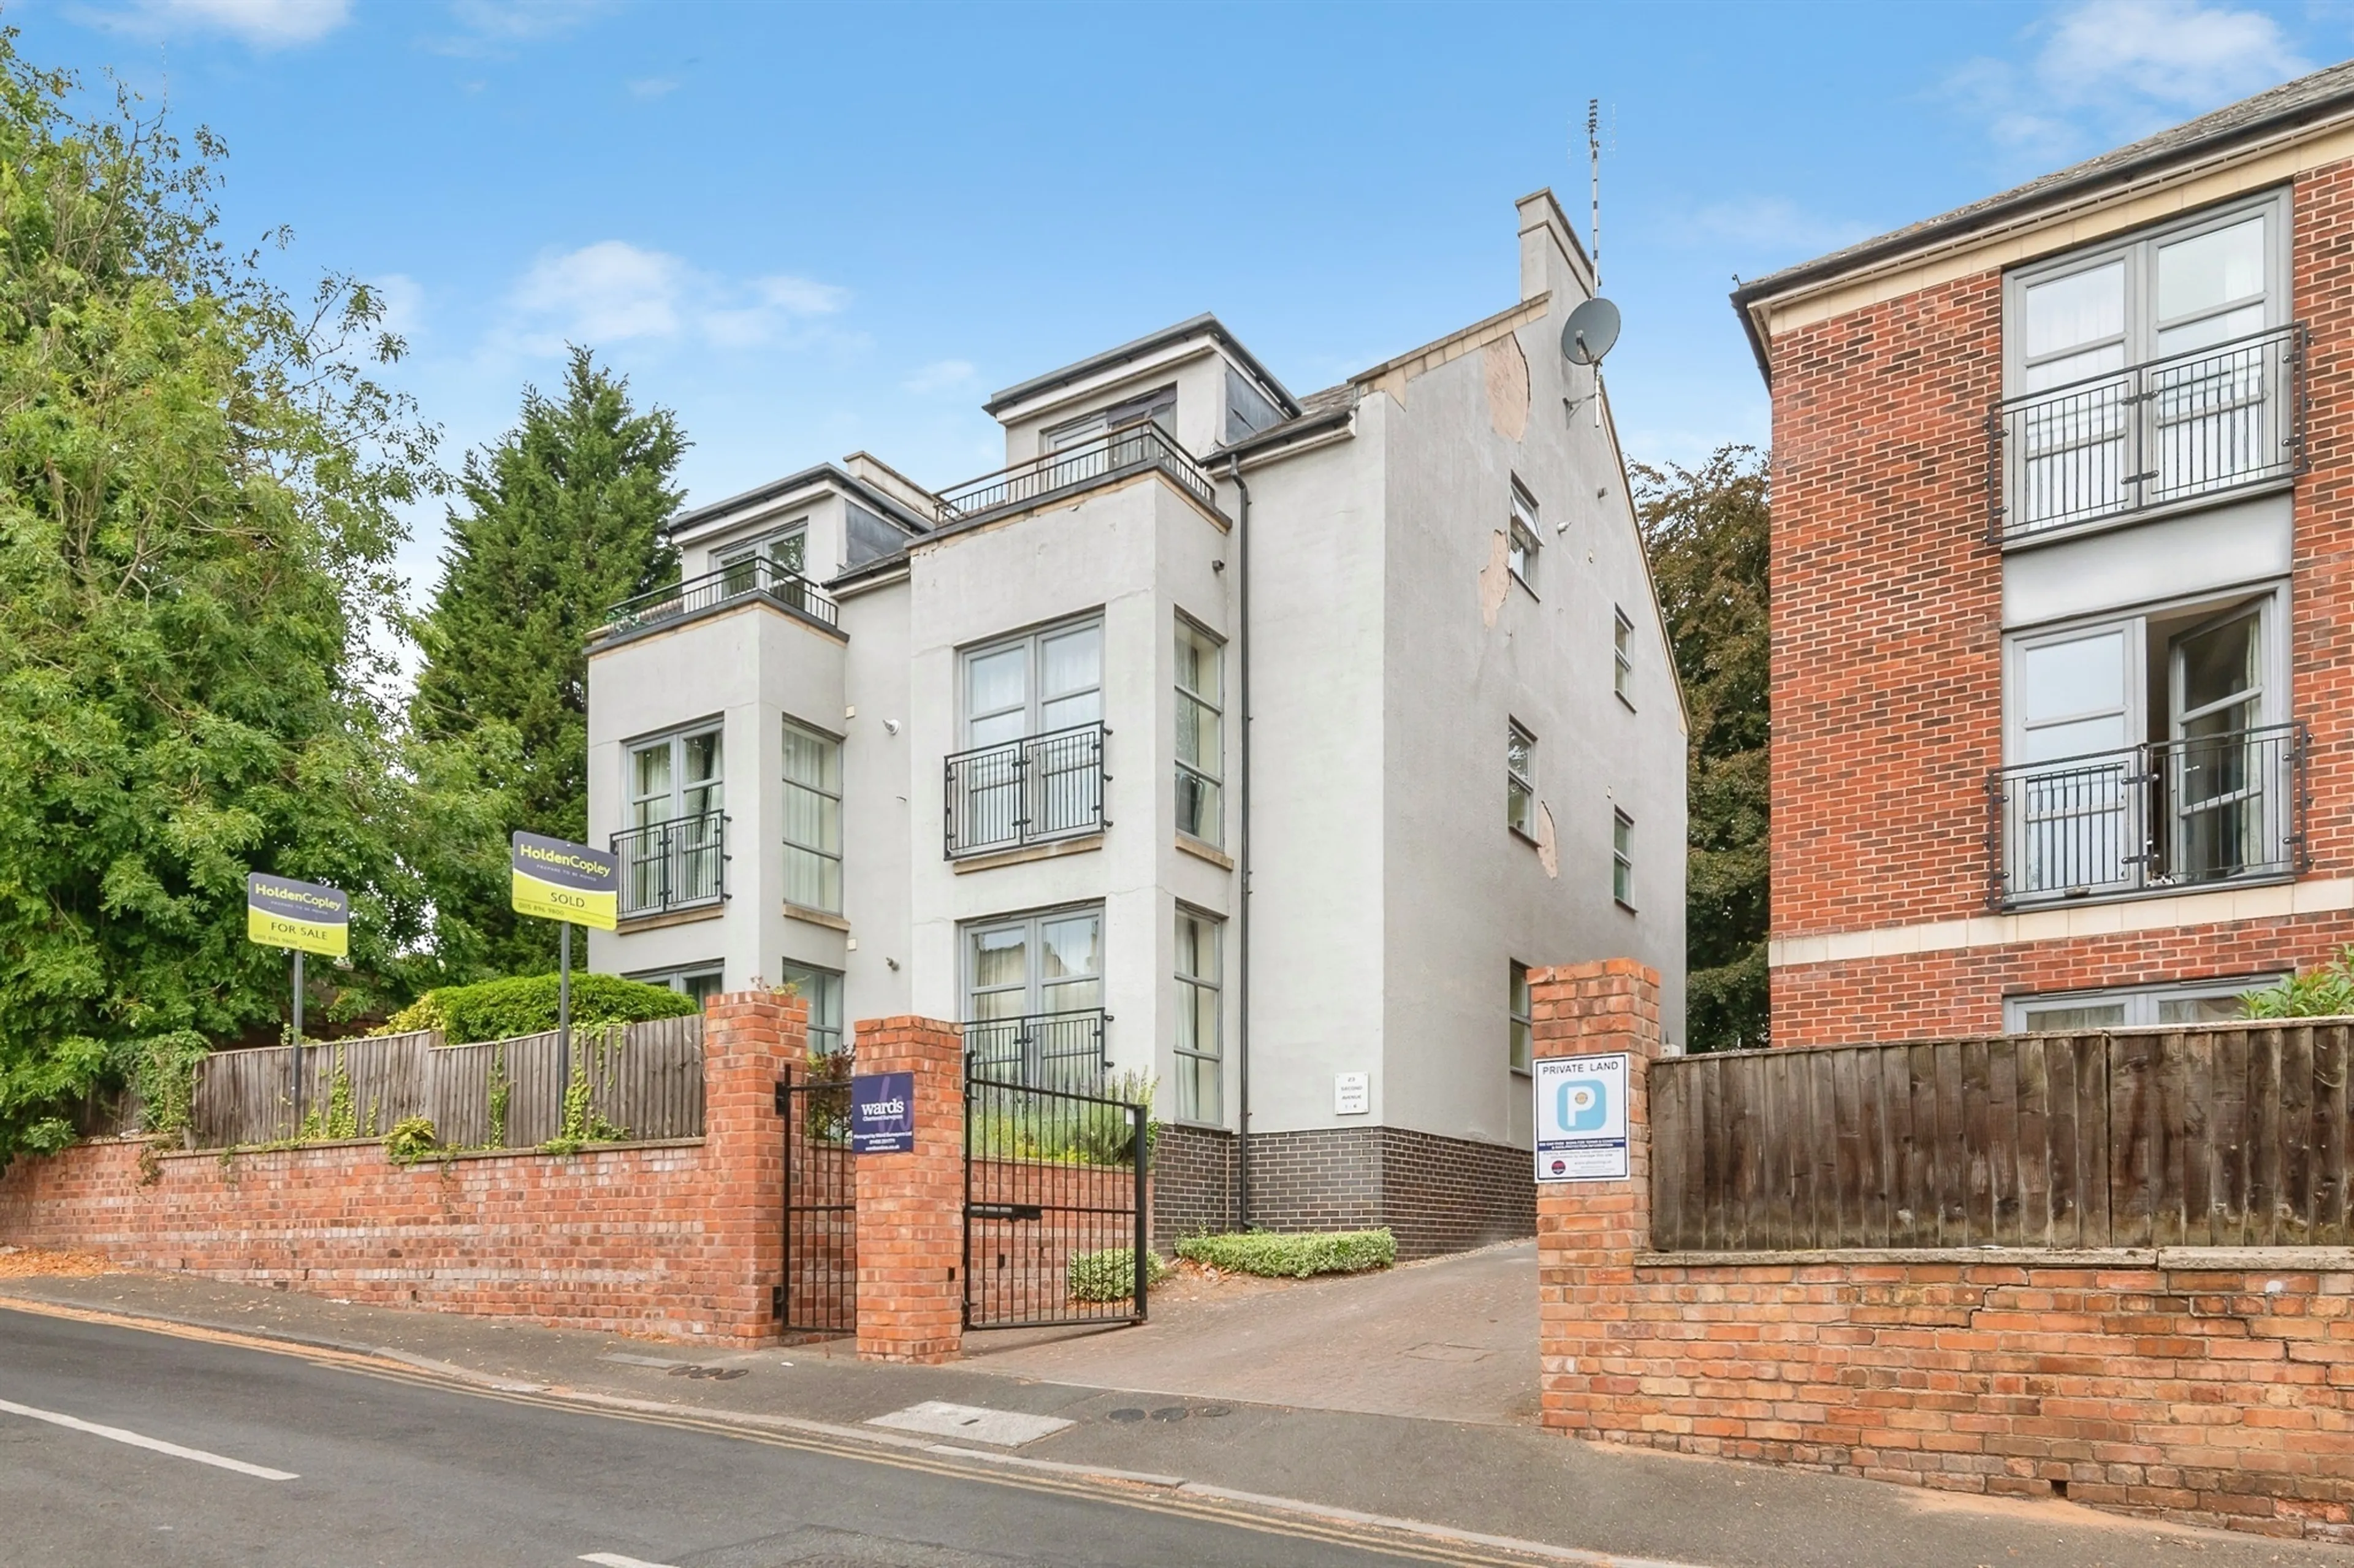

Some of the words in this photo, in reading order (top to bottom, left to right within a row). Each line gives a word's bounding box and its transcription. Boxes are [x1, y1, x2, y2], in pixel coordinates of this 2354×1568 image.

[520, 843, 611, 878] HoldenCopley
[536, 864, 560, 873] PREPARE
[255, 883, 341, 911] HoldenCopley
[550, 892, 585, 908] SOLD
[271, 922, 296, 934] FOR
[300, 927, 328, 940] SALE
[1542, 1064, 1584, 1075] PRIVATE
[1590, 1061, 1618, 1071] LAND
[861, 1098, 904, 1116] wards
